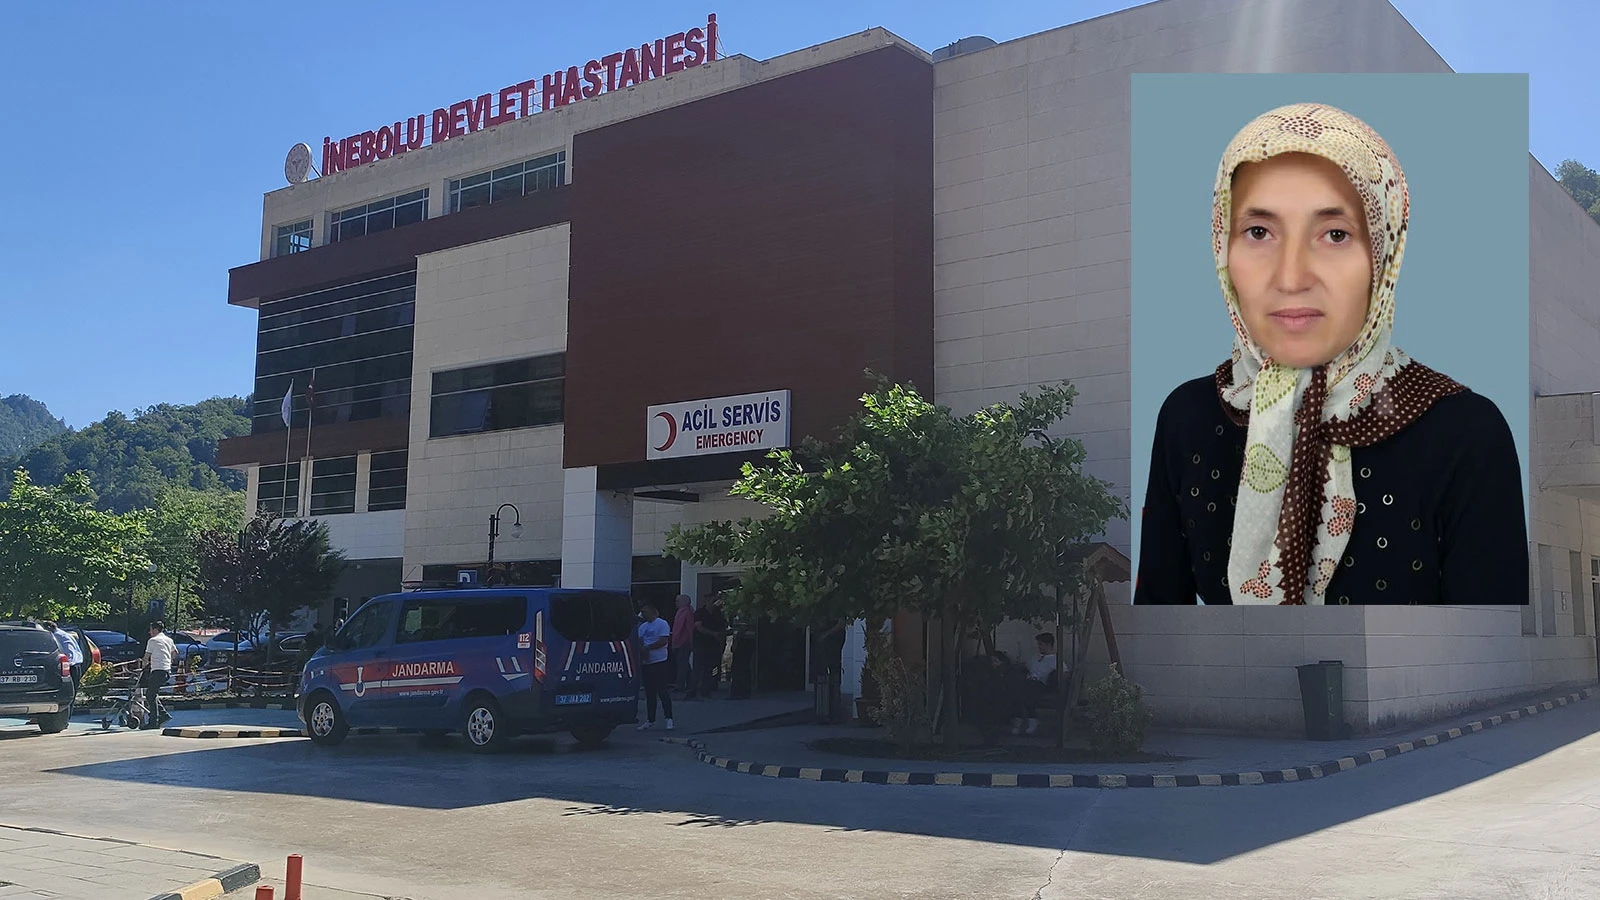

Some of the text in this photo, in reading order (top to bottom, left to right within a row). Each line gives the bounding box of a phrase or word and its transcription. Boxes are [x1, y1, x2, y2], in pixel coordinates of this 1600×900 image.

[322, 13, 717, 177] İNEBOLU DEVLET HASTANESİ
[681, 396, 781, 432] ACİL SERVİS
[696, 429, 764, 450] EMERGENCY
[519, 633, 530, 642] 112
[392, 661, 455, 678] JANDARMA
[576, 661, 624, 674] JANDARMA
